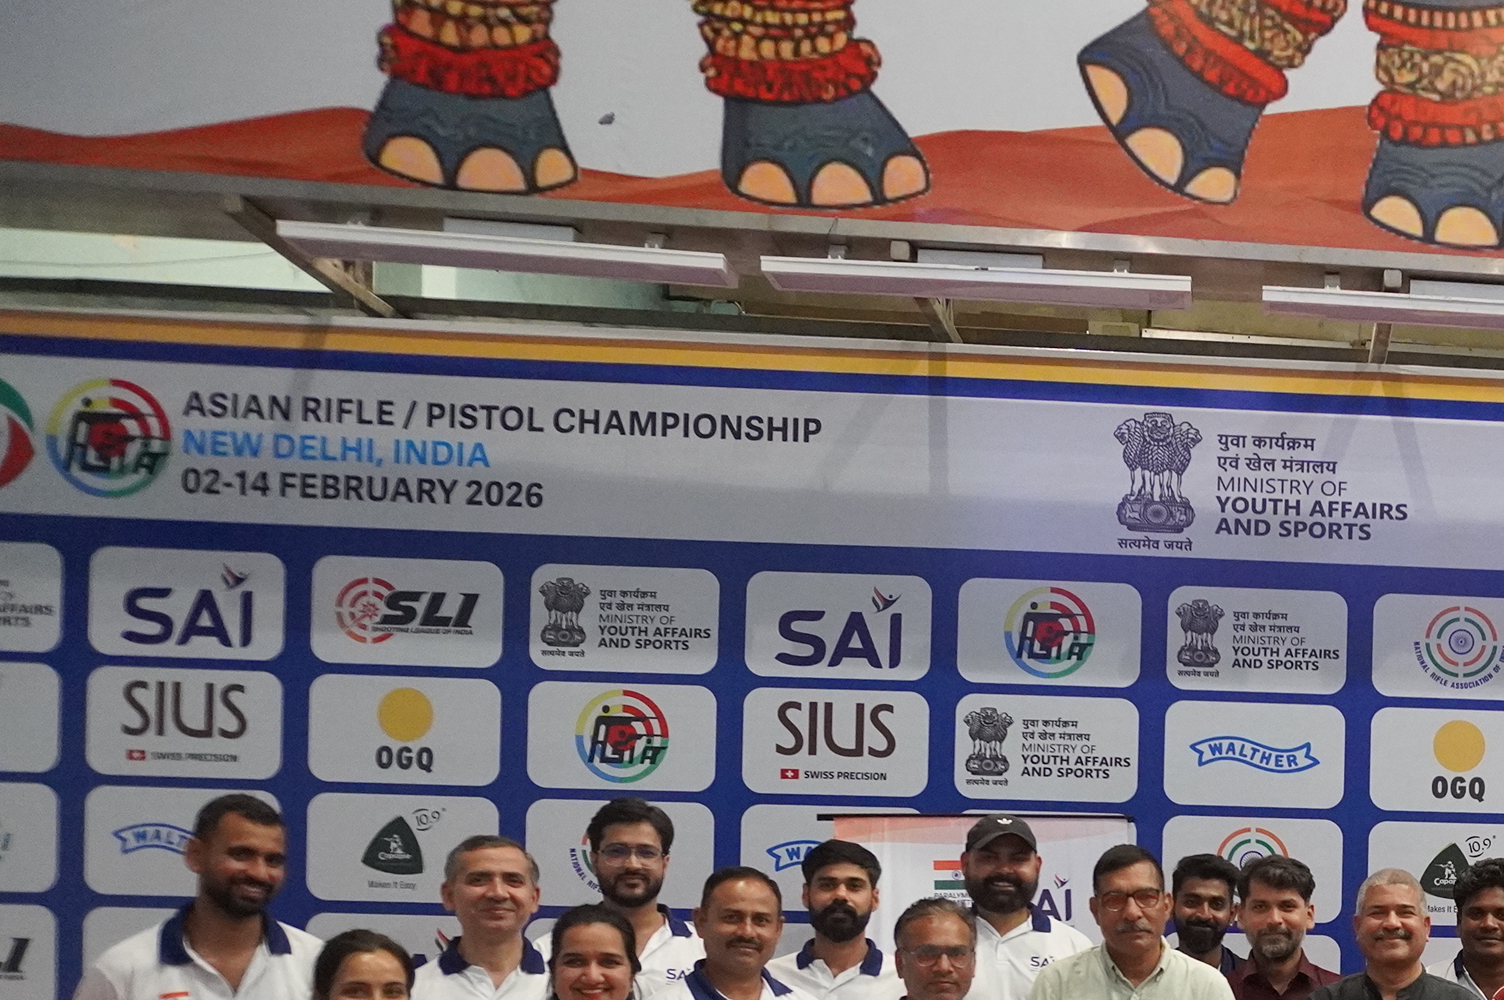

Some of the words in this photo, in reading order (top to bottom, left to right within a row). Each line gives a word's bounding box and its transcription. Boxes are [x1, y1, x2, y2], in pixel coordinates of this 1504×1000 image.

[182, 391, 292, 421] ASIAN
[301, 396, 395, 426] RIFLE
[402, 399, 418, 429] /
[426, 401, 544, 433] PISTOL
[552, 406, 822, 443] CHAMPIONSHIP
[183, 429, 263, 457] NEW
[273, 432, 383, 467] DELHI,
[394, 438, 491, 467] INDIA
[1218, 434, 1246, 451] युवा
[1252, 432, 1315, 451] कार्यक्रम
[1218, 455, 1239, 470] एवं
[1245, 452, 1276, 472] खेल
[1281, 456, 1337, 474] मंत्रालय
[181, 468, 271, 497] 02-14
[279, 472, 458, 504] FEBRUARY
[466, 479, 543, 508] 2026
[1217, 476, 1314, 495] MINISTRY
[1320, 481, 1347, 496] OF
[1215, 496, 1300, 516] YOUTH
[1309, 500, 1408, 520] AFFAIRS
[1215, 518, 1271, 536] AND
[1279, 520, 1371, 540] SPORTS
[1117, 536, 1159, 550] सत्यमेव
[1164, 537, 1192, 551] जयते
[120, 587, 253, 648] SAI
[373, 590, 480, 628] SLI
[1233, 611, 1250, 622] युवा
[1254, 610, 1288, 622] कार्यक्रम
[599, 614, 654, 625] MINISTRY
[660, 616, 675, 625] OF
[1233, 623, 1245, 633] एवं
[1249, 622, 1267, 634] खेल
[1269, 623, 1300, 634] मंत्रालय
[599, 626, 648, 637] YOUTH
[653, 627, 711, 638] AFFAIRS
[775, 610, 902, 669] SAI
[1232, 636, 1287, 646] MINISTRY
[1291, 637, 1306, 647] OF
[598, 638, 630, 648] AND
[635, 640, 689, 650] SPORTS
[1232, 646, 1280, 658] YOUTH
[1284, 649, 1340, 660] AFFAIRS
[1232, 659, 1263, 669] AND
[1267, 660, 1319, 671] SPORTS
[1414, 641, 1429, 673] NATIONAL
[1430, 672, 1449, 687] RIFLE
[1450, 673, 1494, 689] ASSOCIATION
[1493, 664, 1501, 674] OF
[120, 680, 247, 739] SIUS
[775, 700, 896, 758] SIUS
[1022, 718, 1039, 729] युवा
[1042, 717, 1078, 729] कार्यक्रम
[1022, 730, 1035, 741] एवं
[1038, 729, 1056, 742] खेल
[1058, 730, 1090, 742] मंत्रालय
[1021, 743, 1078, 754] MINISTRY
[1081, 744, 1096, 754] OF
[1208, 743, 1299, 769] WALTHER
[376, 745, 434, 773] OGQ
[1021, 754, 1071, 766] YOUTH
[1074, 756, 1131, 767] AFFAIRS
[804, 770, 835, 780] SWISS
[837, 771, 887, 781] PRECISION
[1021, 766, 1054, 777] AND
[1057, 767, 1110, 779] SPORTS
[1432, 776, 1486, 802] OGQ
